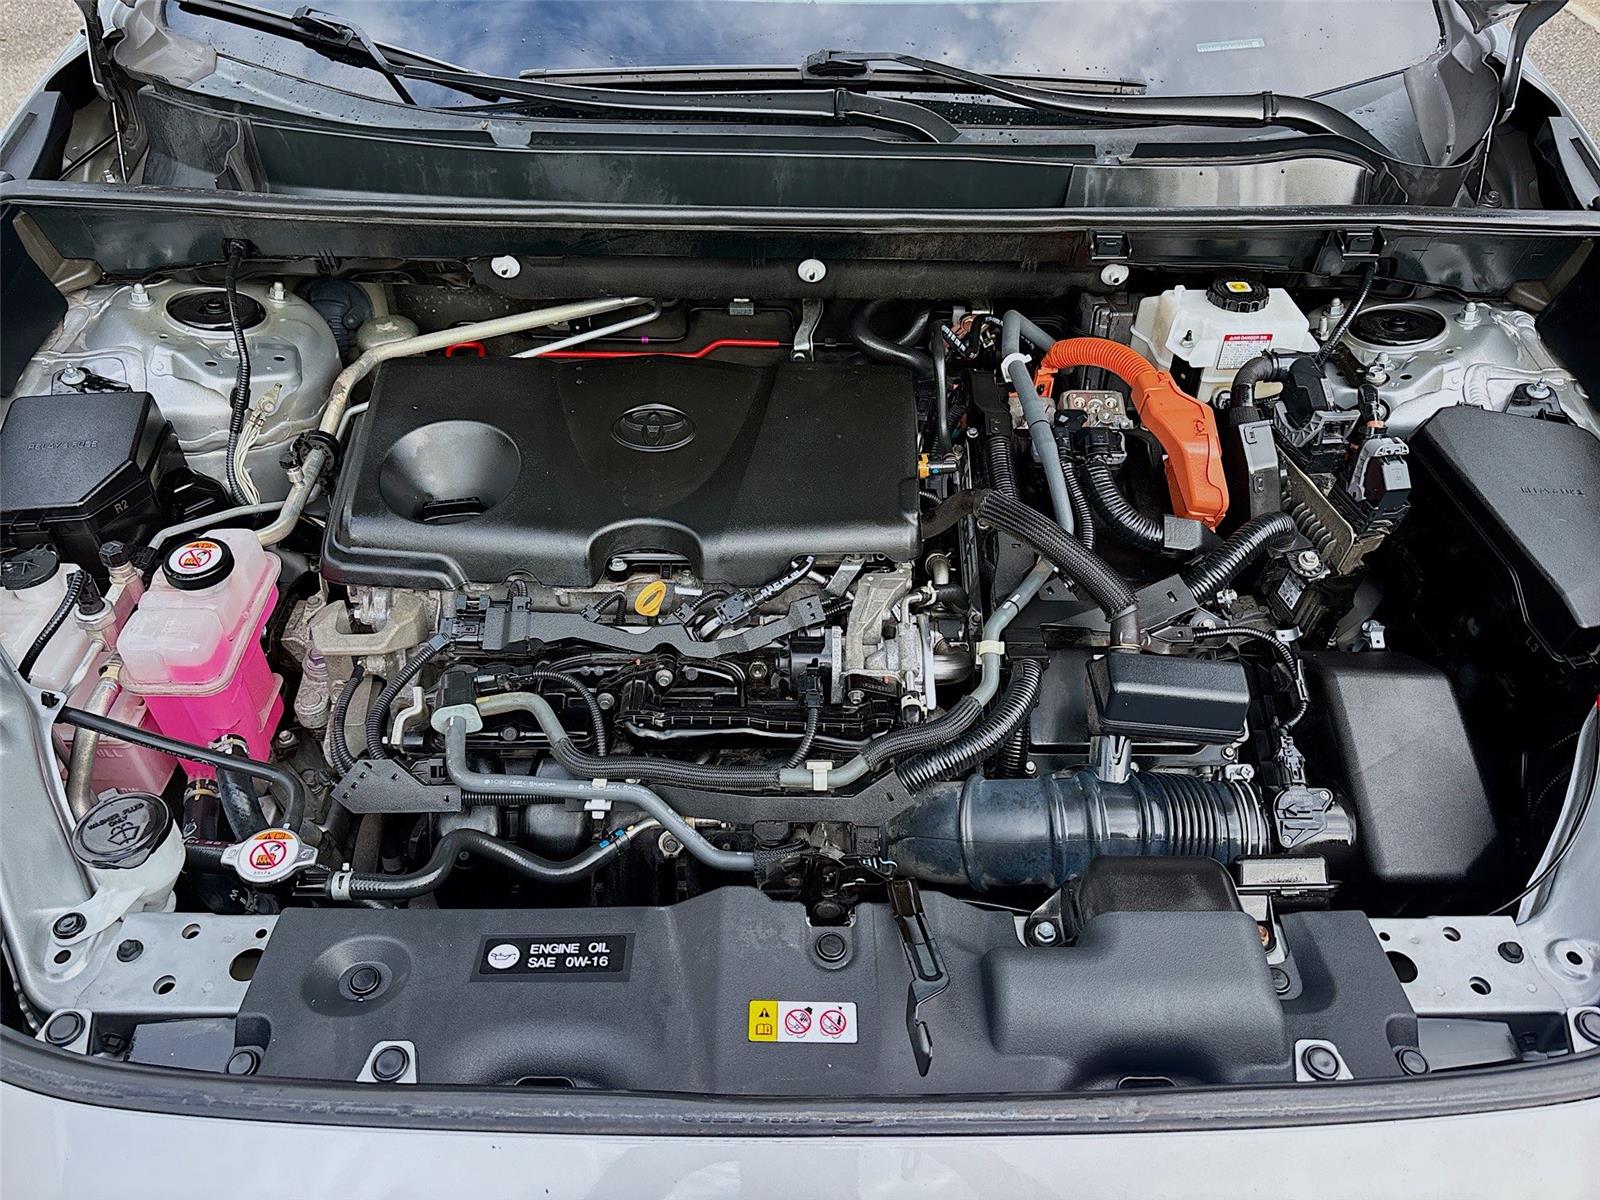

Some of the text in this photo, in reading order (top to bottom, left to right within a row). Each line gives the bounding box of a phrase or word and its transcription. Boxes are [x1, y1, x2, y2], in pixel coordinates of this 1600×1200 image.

[114, 500, 129, 514] R2
[529, 943, 610, 954] ENGINE OIL
[527, 955, 609, 968] SAE 0W-16
